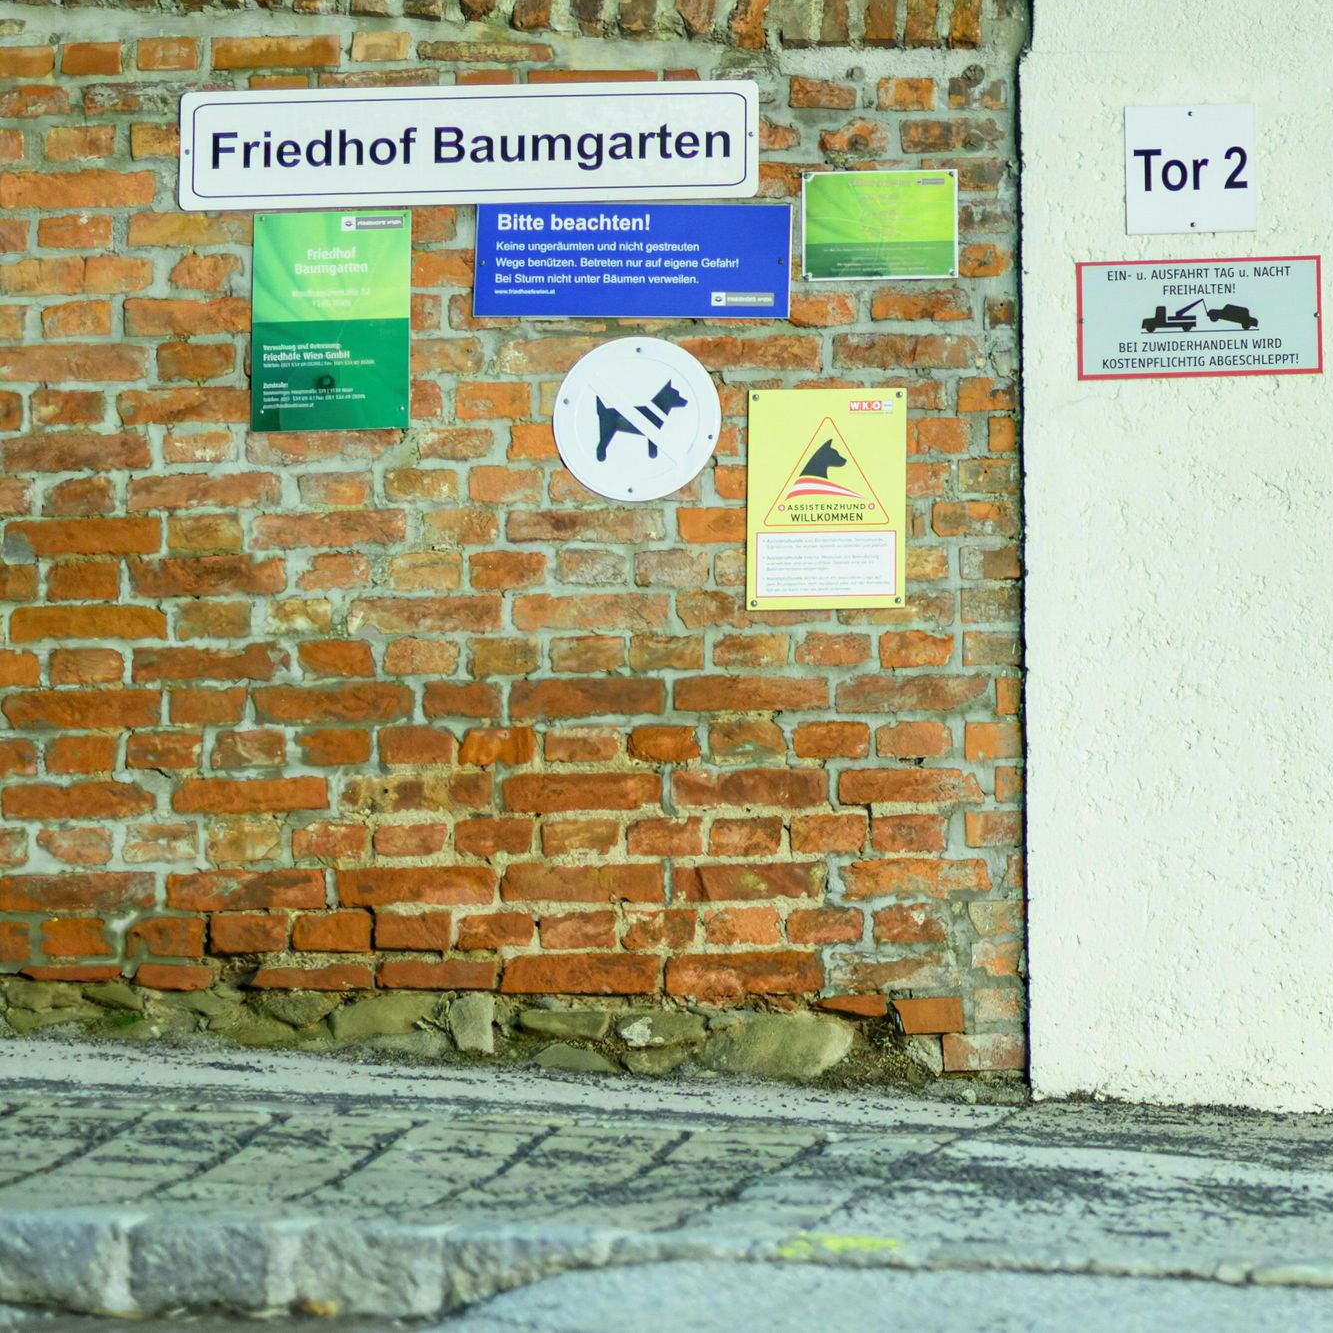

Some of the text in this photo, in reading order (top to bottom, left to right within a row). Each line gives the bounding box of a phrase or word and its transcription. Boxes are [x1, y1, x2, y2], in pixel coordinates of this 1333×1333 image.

[212, 123, 731, 171] Friedhof Baumgarten
[1133, 146, 1248, 192] Tor 2
[498, 213, 650, 231] Bitte beachten!
[307, 246, 356, 260] Friedhof
[496, 241, 700, 253] Keine ungeräumten und nicht gestreuten
[294, 263, 368, 276] Baumgarten
[496, 257, 525, 269] Wege
[528, 257, 577, 268] benützen.
[580, 257, 623, 267] Betreten
[645, 258, 661, 268] auf
[664, 258, 698, 270] eigene
[701, 258, 739, 268] Gefahr!
[495, 273, 699, 284] Bei Sturm nicht unter Bäumen verweilen.
[1107, 266, 1291, 282] EIN- u. AUSFAHRT TAG u. NACHT
[1162, 283, 1236, 296] FREIHALTEN!
[1118, 338, 1282, 353] BEI ZUWIDERHANDELN WIRD
[303, 351, 323, 360] Wien
[325, 351, 350, 359] GmbH
[1102, 353, 1299, 369] KOSTENPFLICHTIG ABGESCHLEPPT!
[787, 503, 866, 511] ASSISTENZHUND
[791, 513, 863, 522] WILLKOMMEN
